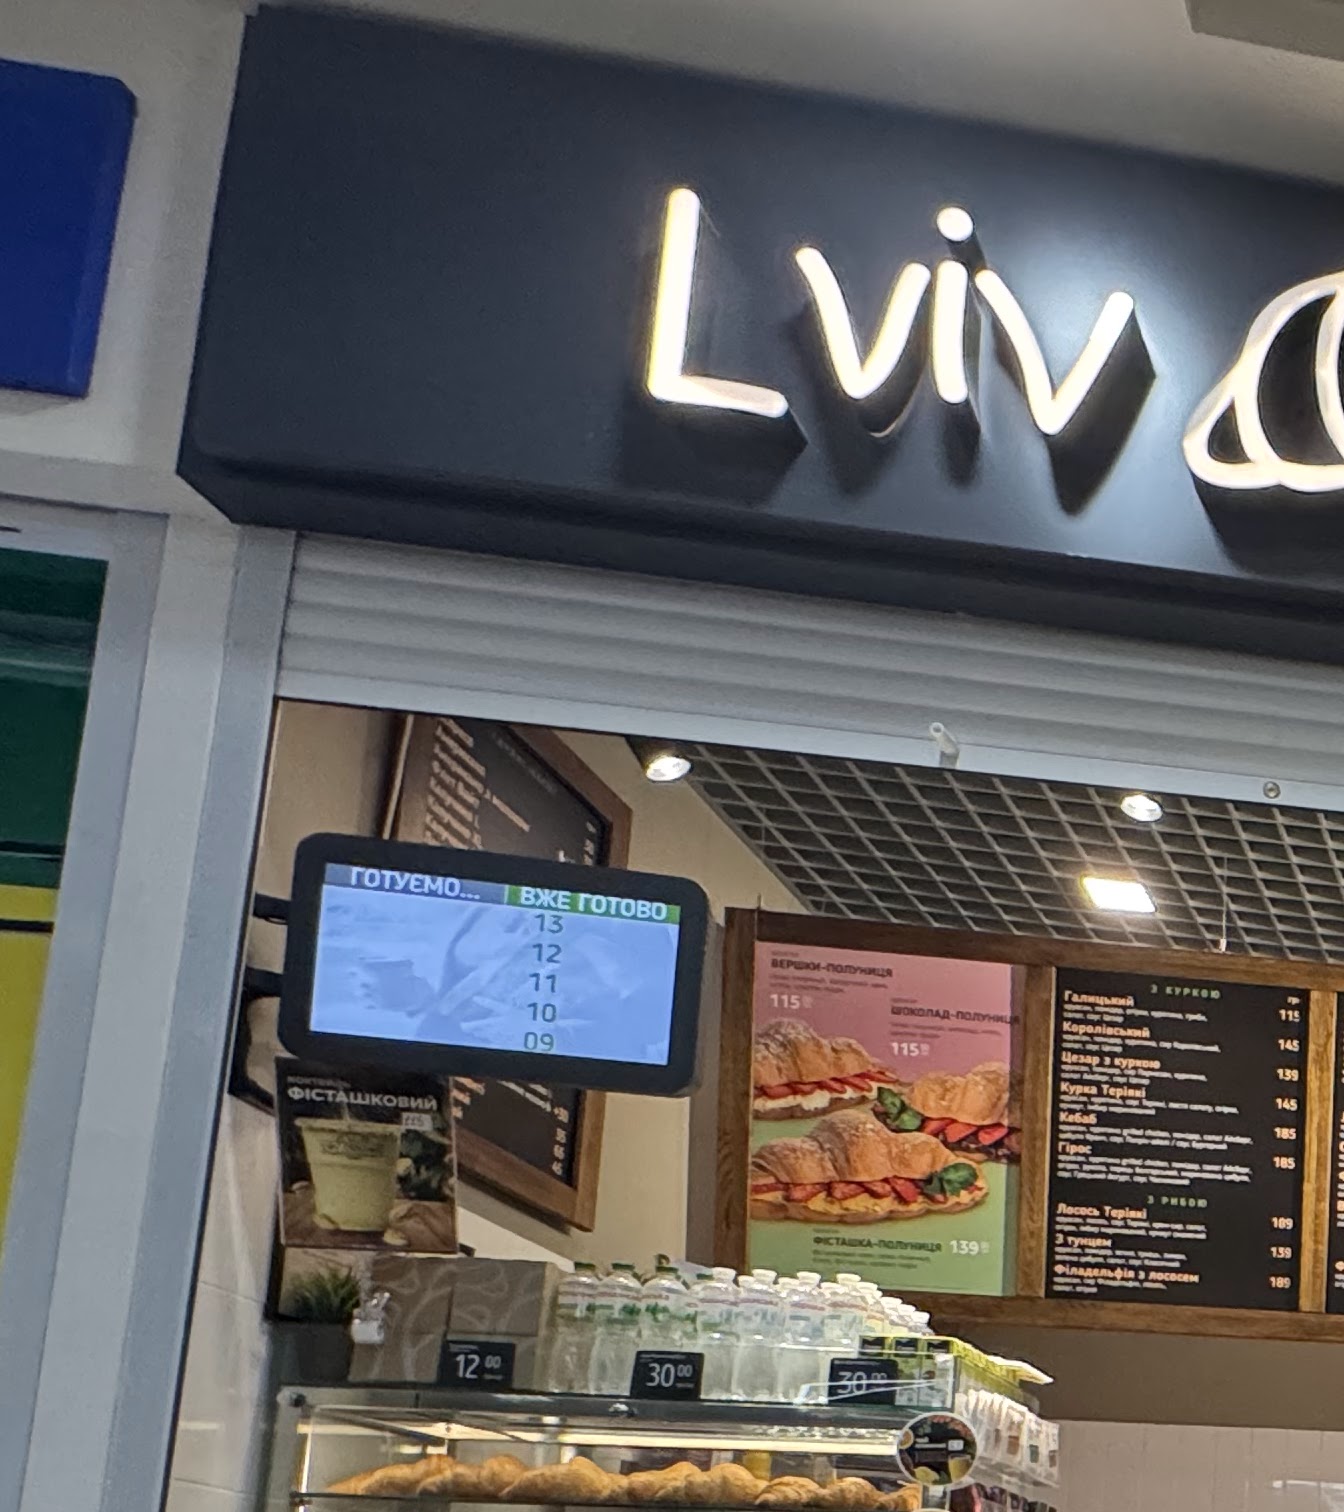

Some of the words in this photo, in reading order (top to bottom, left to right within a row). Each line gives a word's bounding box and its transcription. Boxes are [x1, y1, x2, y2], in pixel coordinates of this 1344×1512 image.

[520, 886, 571, 910] ВЖЕ
[576, 892, 667, 921] ГОТОВО
[533, 914, 563, 934] 13
[532, 944, 561, 964] 12
[529, 973, 557, 993] 11
[770, 994, 801, 1009] 115
[527, 1002, 556, 1023] 10
[1279, 1009, 1300, 1022] 115
[523, 1032, 554, 1052] 09
[891, 1041, 920, 1056] 115
[288, 1086, 438, 1111] ФІСТАШКОВИЙ
[950, 1240, 980, 1255] 139
[455, 1353, 480, 1379] 12
[485, 1355, 501, 1368] 00
[646, 1362, 675, 1387] 30
[677, 1364, 693, 1377] 00
[836, 1371, 867, 1394] 30
